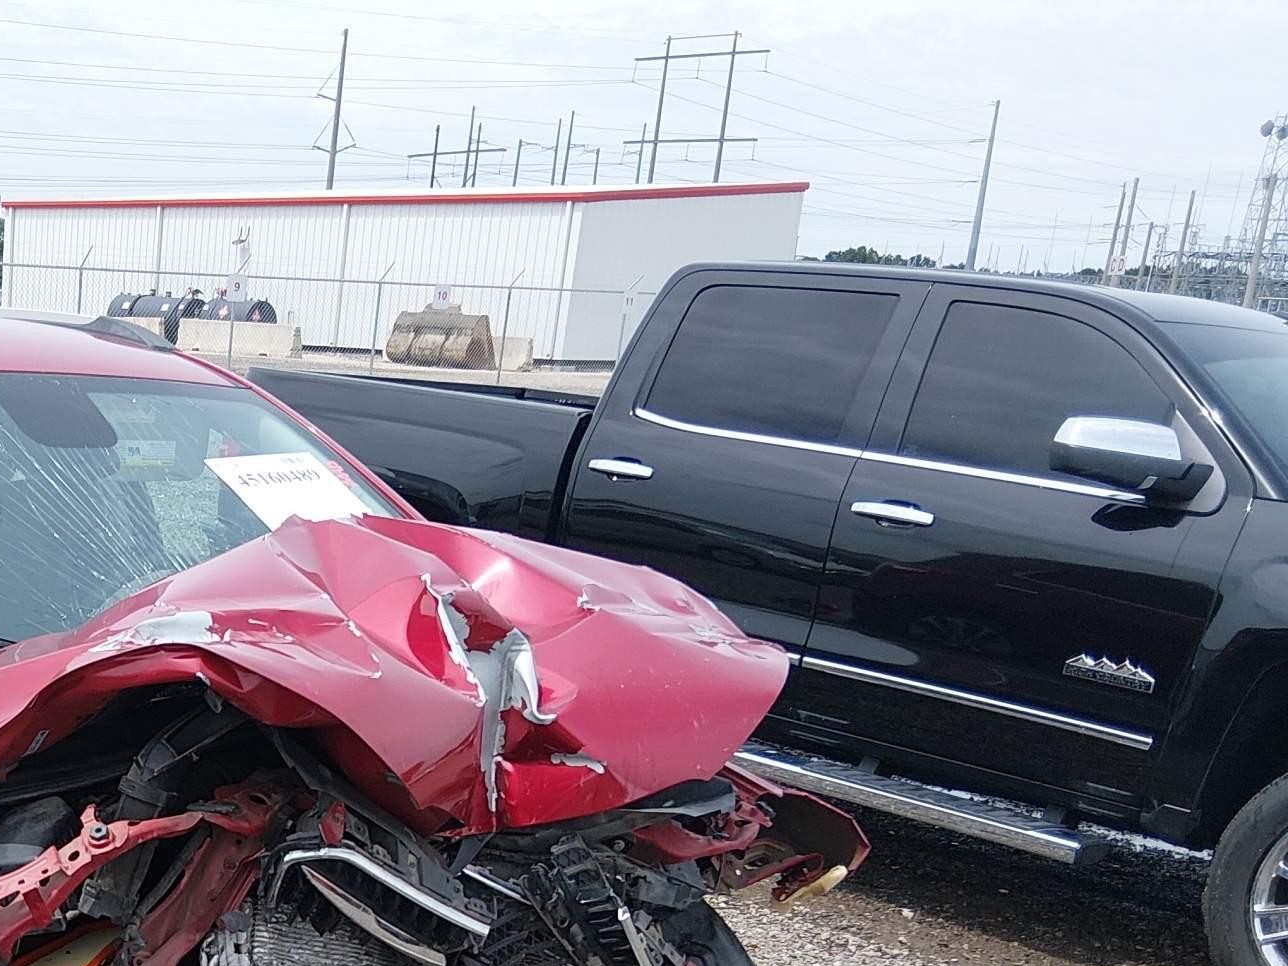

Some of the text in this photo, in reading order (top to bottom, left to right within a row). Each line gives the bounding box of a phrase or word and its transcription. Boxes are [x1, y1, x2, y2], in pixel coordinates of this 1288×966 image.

[234, 281, 241, 292] 9
[438, 291, 448, 301] 10
[625, 297, 634, 306] 11
[237, 468, 321, 488] 45160489
